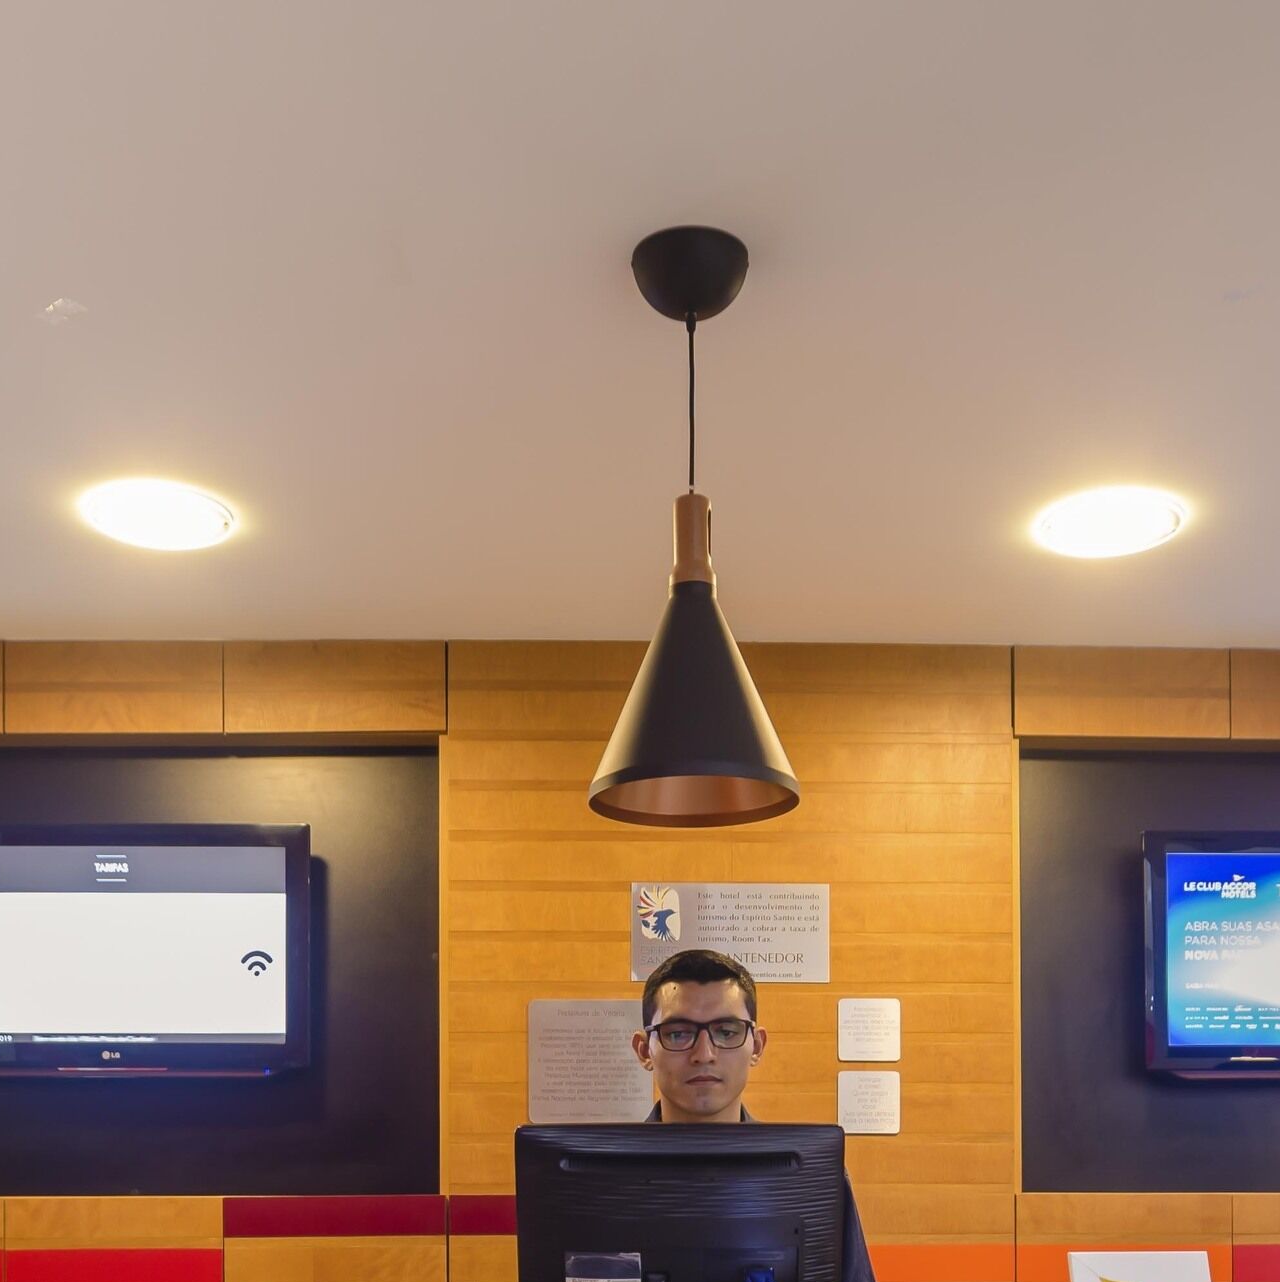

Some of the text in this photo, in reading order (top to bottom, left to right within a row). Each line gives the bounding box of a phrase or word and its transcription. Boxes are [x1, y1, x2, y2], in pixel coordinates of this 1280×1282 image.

[94, 862, 129, 873] TARIFAS
[1183, 882, 1196, 891] LE
[1197, 882, 1221, 891] CLUB
[697, 892, 713, 900] Este
[720, 892, 740, 900] hotel
[769, 892, 820, 900] contribuindo
[697, 904, 715, 912] para
[734, 903, 803, 911] desenvolvimento
[809, 903, 820, 911] do
[697, 913, 726, 921] turismo
[729, 913, 740, 921] do
[773, 913, 795, 921] Santo
[697, 924, 740, 932] autorizado
[752, 924, 778, 932] cobrar
[810, 924, 820, 932] de
[1184, 921, 1219, 931] ABRA
[1221, 921, 1252, 931] SUAS
[732, 935, 755, 943] Room
[1184, 935, 1261, 945] PARA NOSSA
[1184, 950, 1219, 961] NOVA
